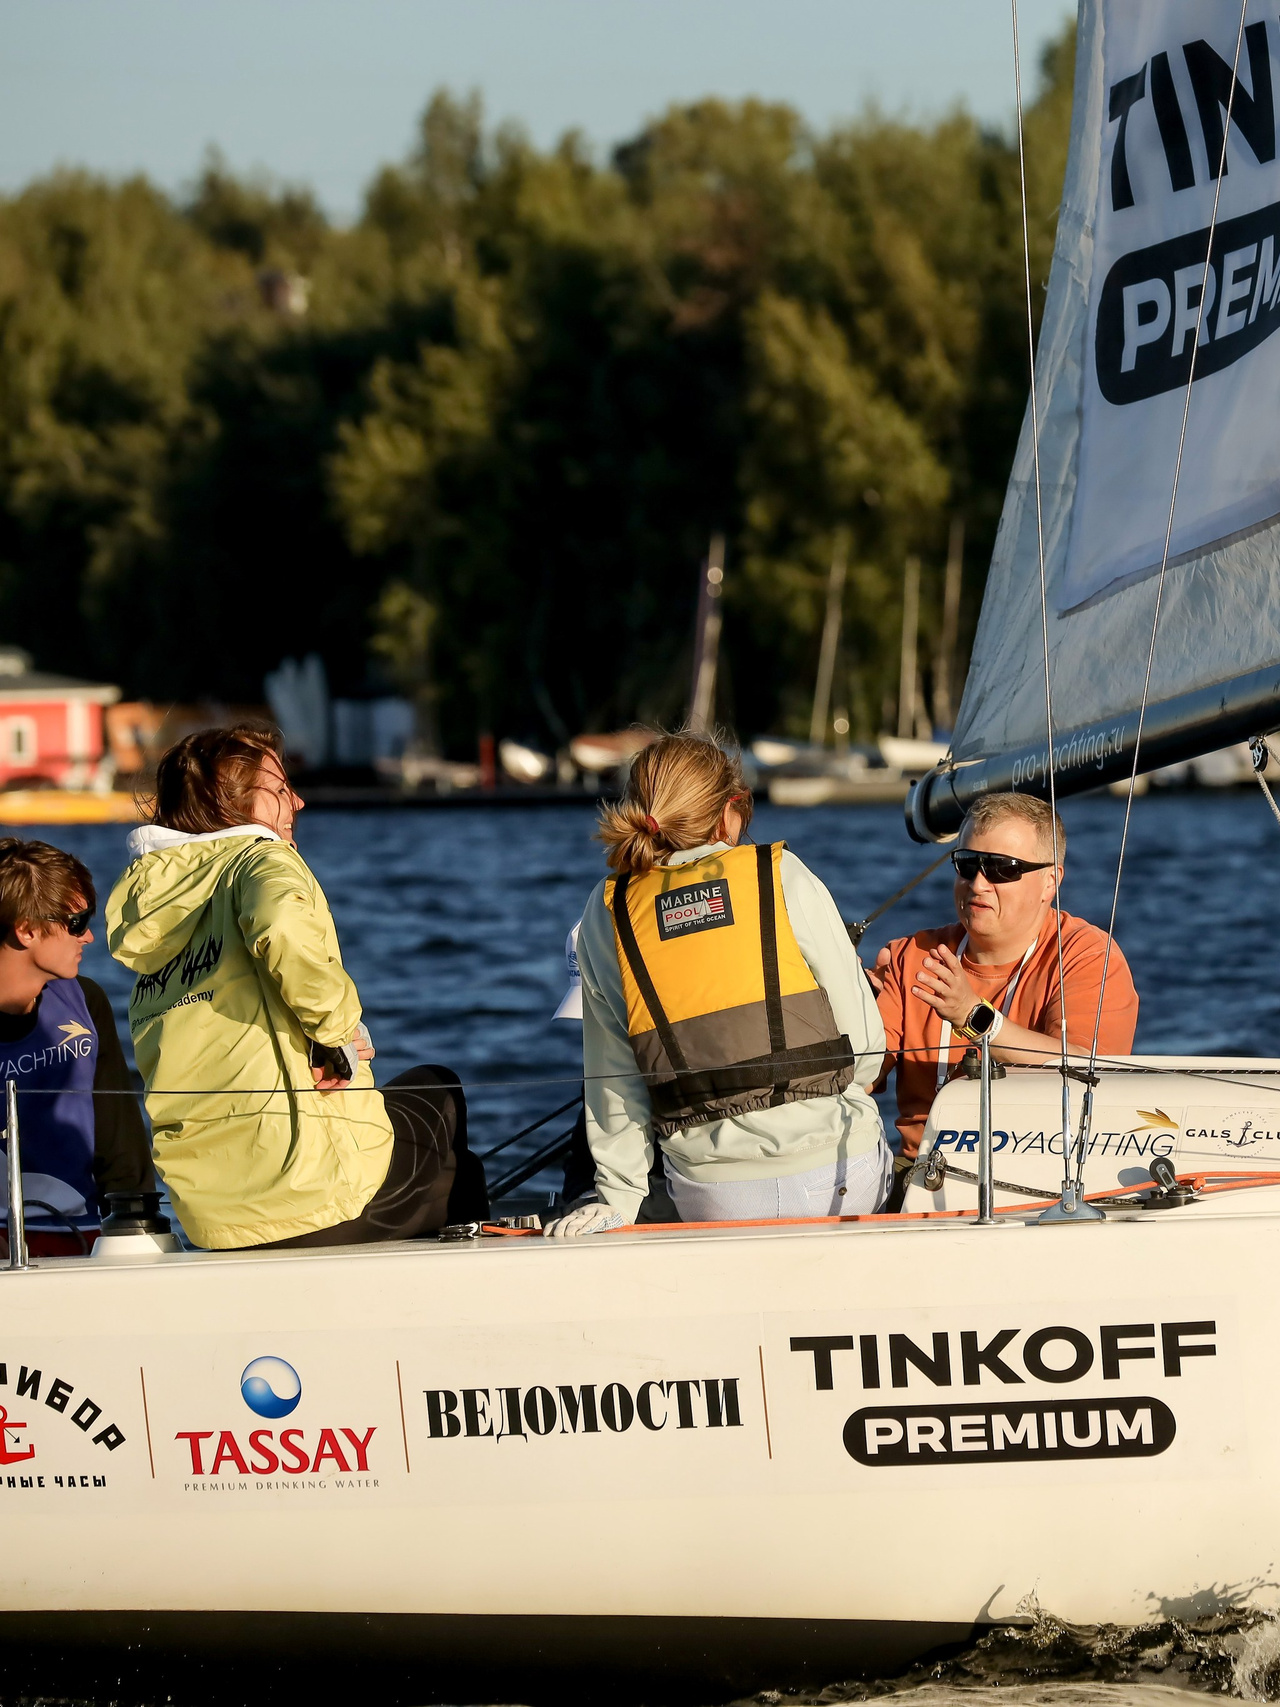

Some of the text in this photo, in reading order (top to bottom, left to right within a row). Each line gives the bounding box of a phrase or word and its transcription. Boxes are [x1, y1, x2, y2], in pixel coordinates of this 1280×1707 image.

[1011, 726, 1126, 793] pro-yachting.ru
[660, 886, 722, 910] MARINE
[665, 907, 701, 922] POOL
[664, 924, 684, 933] SPIRIT
[693, 918, 705, 926] THE
[706, 913, 726, 923] OCEAN
[1185, 1128, 1231, 1139] GALS
[789, 1320, 1217, 1391] TINKOFF
[0, 1362, 127, 1452] ИБОР
[423, 1377, 744, 1444] ВЕДОМОСТИ
[864, 1408, 1154, 1455] PREMIUM
[174, 1427, 378, 1475] TASSAY
[54, 1475, 107, 1488] ЧАСЫ
[184, 1479, 380, 1492] PREMIUM DRINKING WATER
